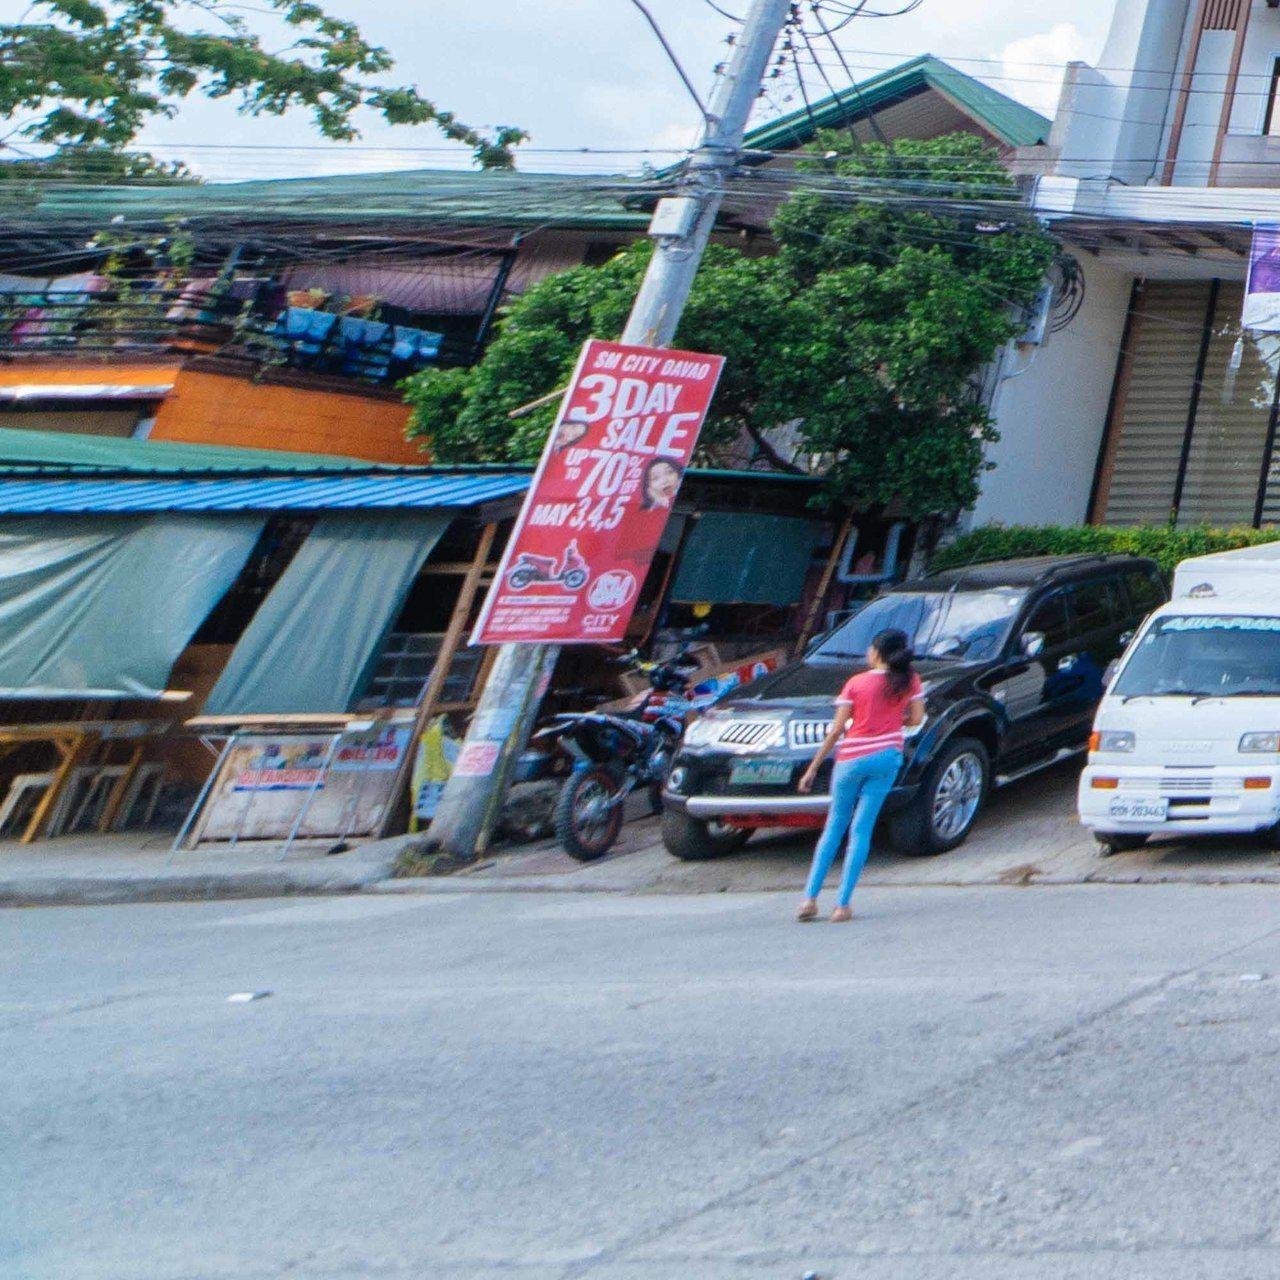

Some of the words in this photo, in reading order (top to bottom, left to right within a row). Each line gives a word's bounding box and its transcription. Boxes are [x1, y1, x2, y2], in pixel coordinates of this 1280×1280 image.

[593, 351, 620, 370] SM
[621, 354, 662, 375] CITY
[661, 359, 711, 380] DAVAO
[601, 412, 700, 458] SALE
[564, 447, 590, 466] UP
[529, 502, 577, 527] MAY
[582, 614, 620, 628] CITY
